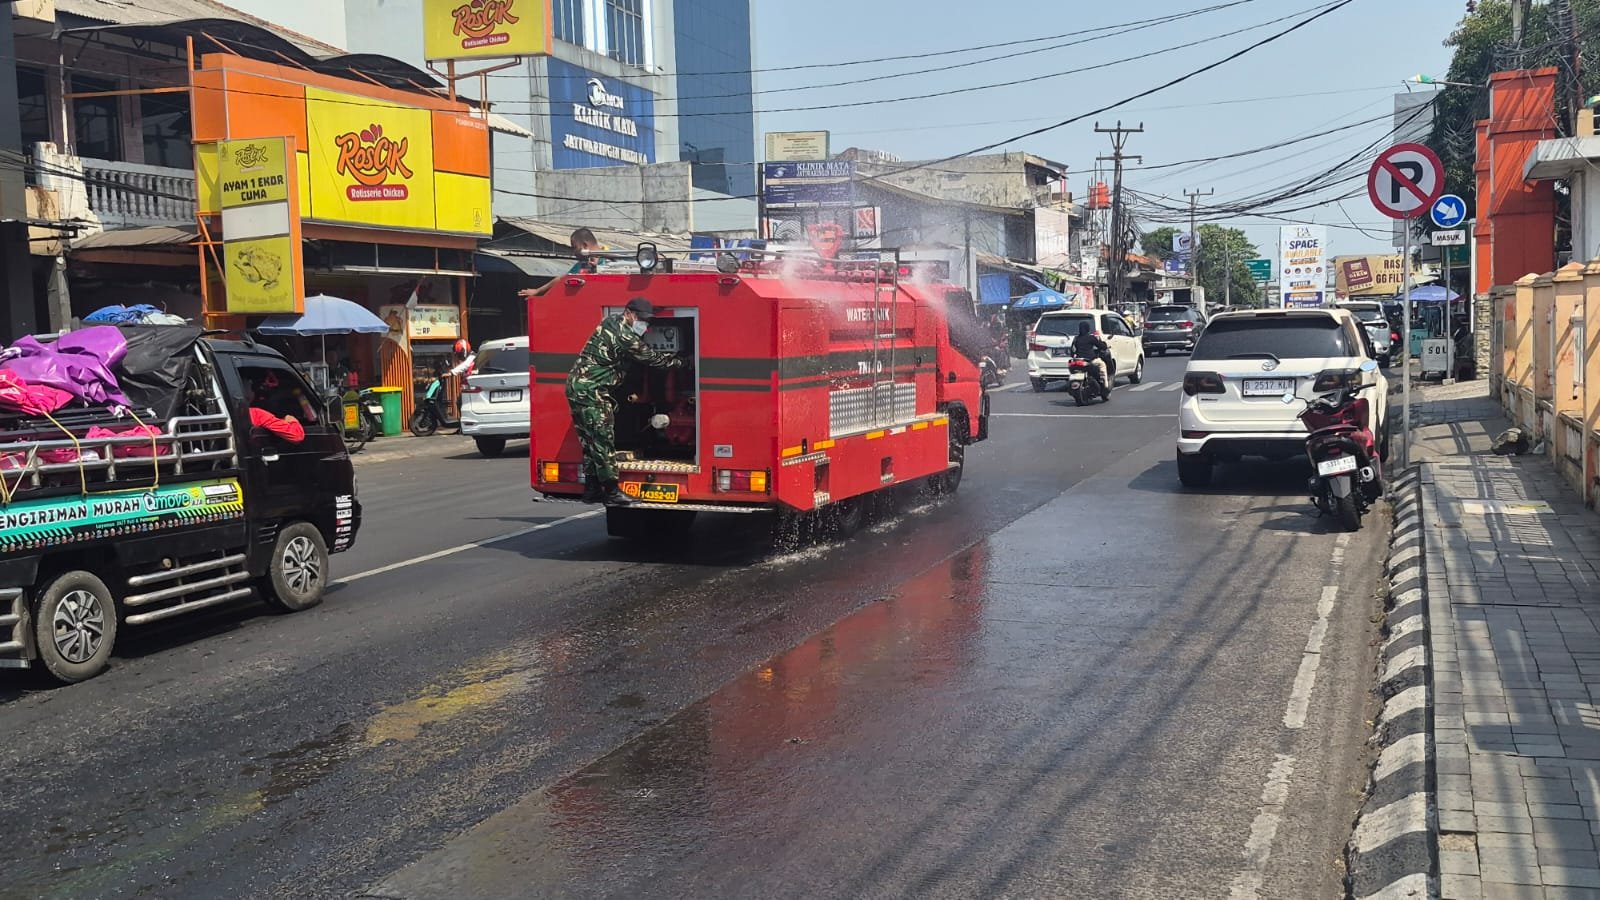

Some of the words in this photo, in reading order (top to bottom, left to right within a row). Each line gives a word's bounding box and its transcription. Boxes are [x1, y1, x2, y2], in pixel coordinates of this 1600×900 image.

[573, 103, 612, 130] KLINIK
[613, 116, 637, 137] MATA
[796, 162, 825, 171] KLINIK
[826, 161, 850, 170] MATA
[223, 180, 249, 192] AYAM
[251, 178, 255, 188] 1
[259, 174, 284, 187] EKOR
[1391, 161, 1423, 203] P
[241, 190, 267, 201] CUMA
[351, 188, 382, 199] Rotisserie
[383, 187, 405, 198] Chicken
[1289, 239, 1319, 250] SPACE
[1284, 248, 1323, 258] AVAILABLE
[1376, 273, 1387, 284] GG
[846, 307, 871, 321] WATER
[1254, 381, 1274, 390] 2517
[640, 491, 675, 500] 14352-03
[93, 499, 140, 516] MURAH
